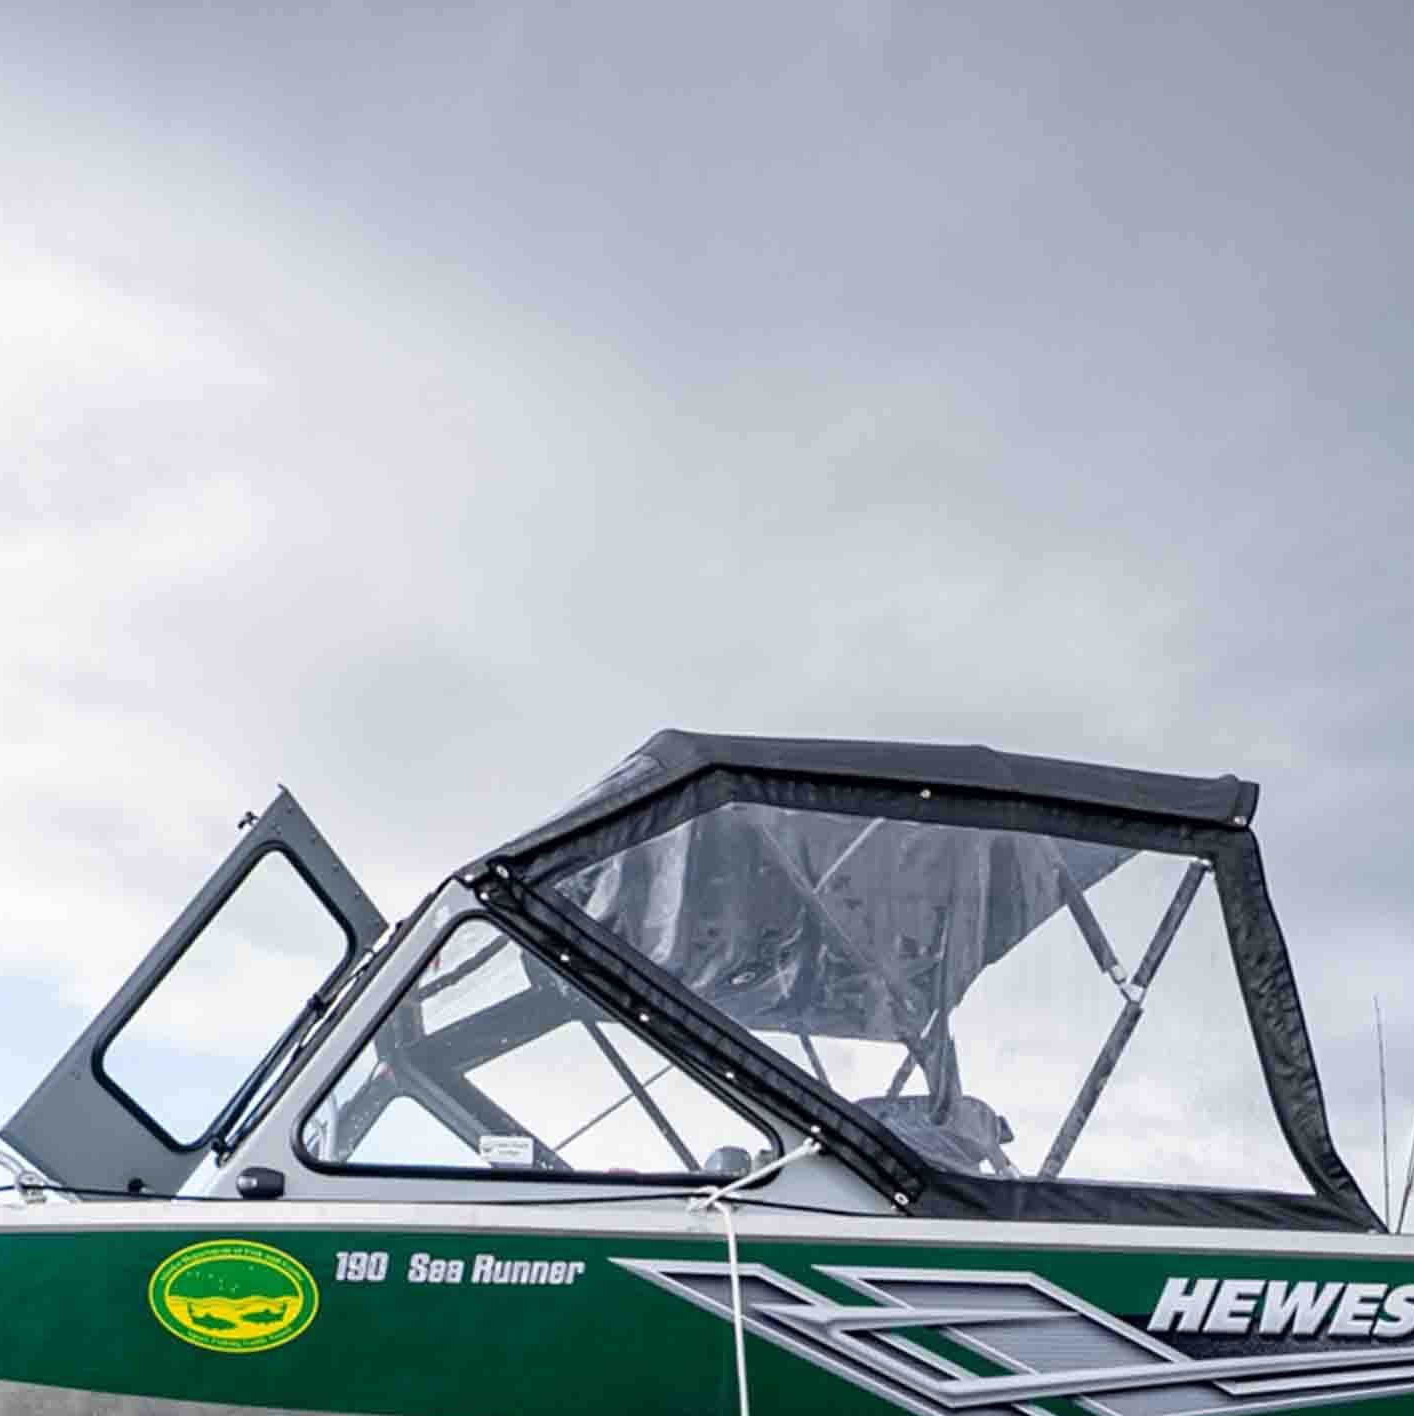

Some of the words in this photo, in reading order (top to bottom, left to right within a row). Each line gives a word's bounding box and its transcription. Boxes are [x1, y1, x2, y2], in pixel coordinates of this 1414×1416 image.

[335, 1251, 388, 1281] 190
[408, 1253, 465, 1283] Sea
[472, 1254, 585, 1285] Runner
